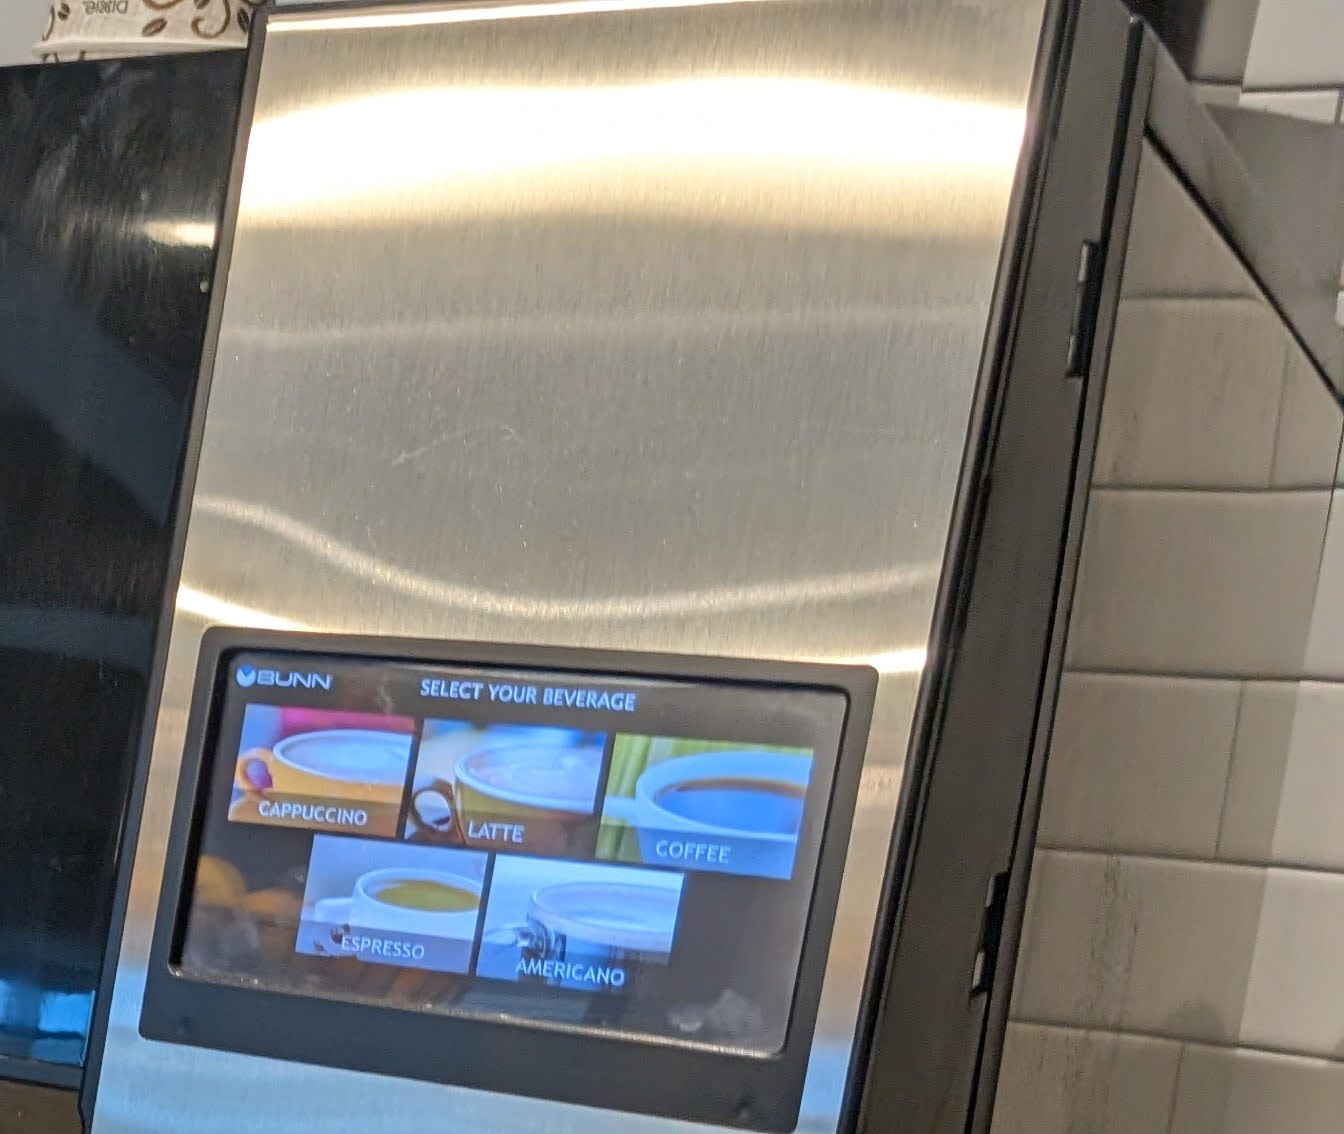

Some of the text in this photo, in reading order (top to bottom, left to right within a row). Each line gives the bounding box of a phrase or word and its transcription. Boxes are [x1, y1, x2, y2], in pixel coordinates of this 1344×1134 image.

[256, 670, 333, 691] BUNN
[420, 678, 636, 713] SELECT YOUR BEVERAGE
[258, 799, 368, 827] CAPPUCCINO
[467, 821, 525, 845] LATTE
[655, 839, 732, 865] COFFEE
[340, 936, 426, 961] ESPRESSO
[515, 957, 626, 987] AMERICANO
